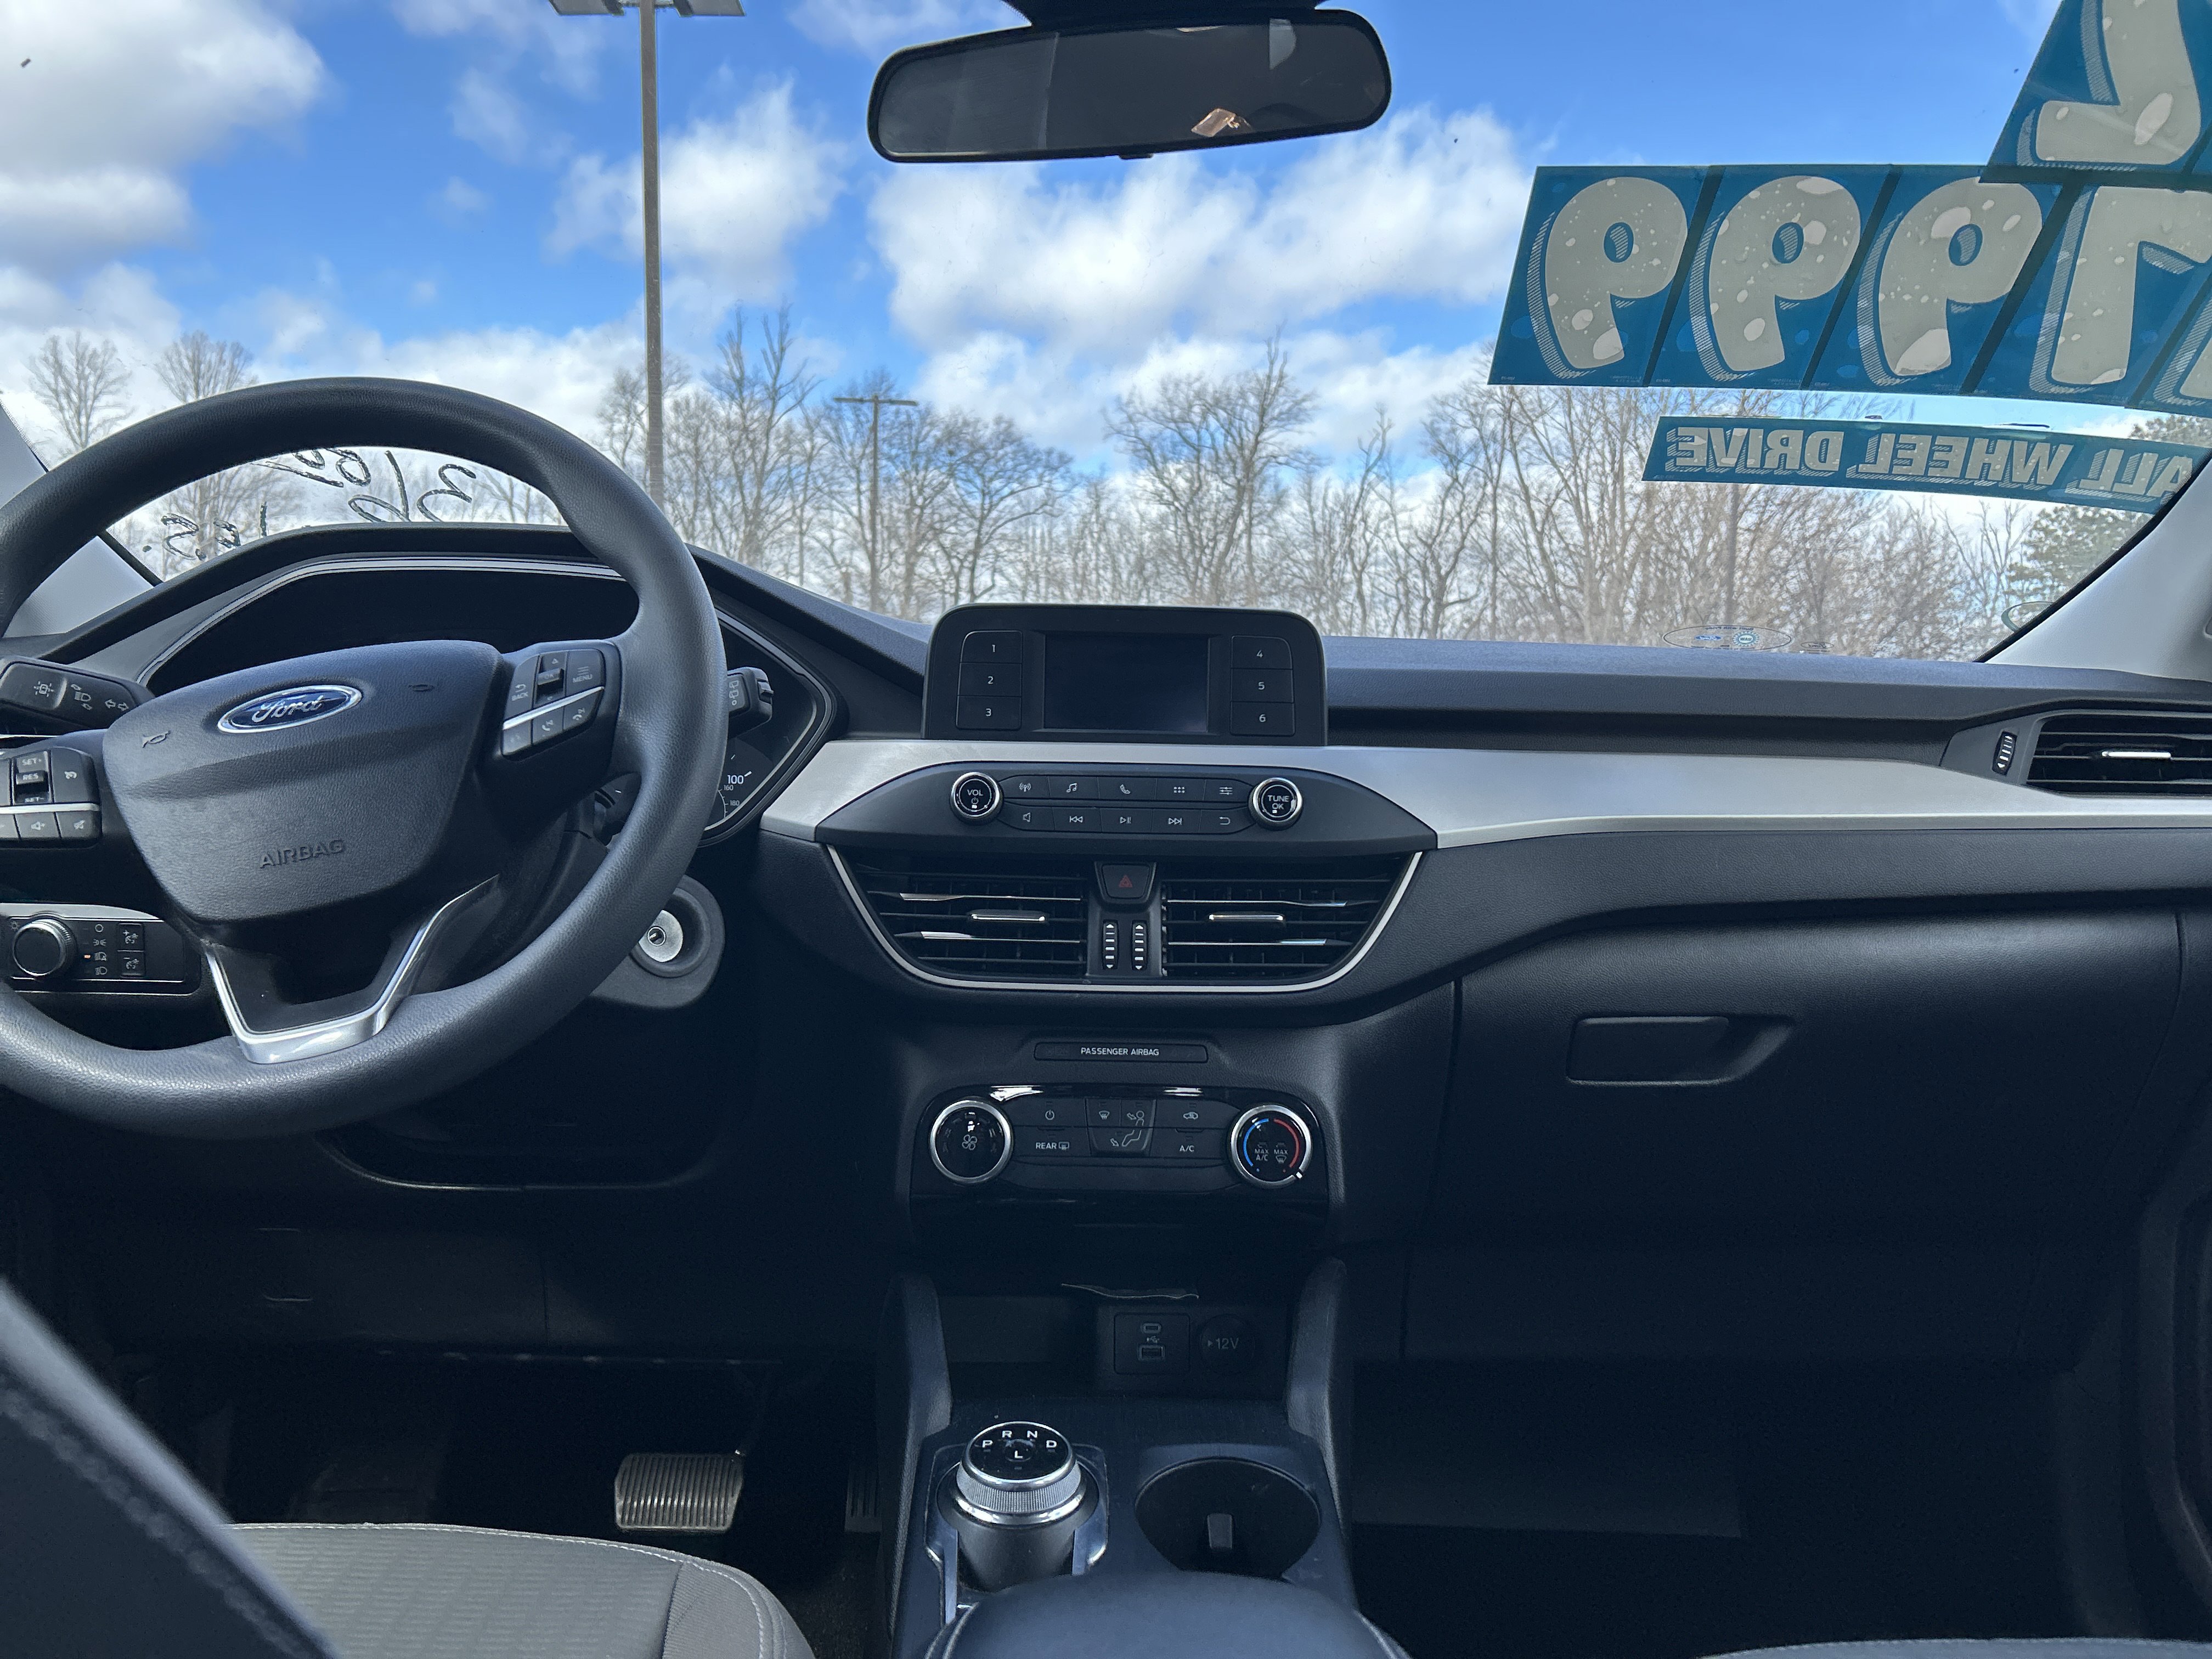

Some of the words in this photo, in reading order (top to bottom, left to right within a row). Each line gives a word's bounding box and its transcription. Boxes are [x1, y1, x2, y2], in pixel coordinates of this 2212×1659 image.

[1256, 650, 1263, 658] 4
[572, 674, 593, 683] MENU
[988, 676, 994, 684] 2
[1258, 681, 1265, 690] 5
[511, 691, 528, 701] BACK
[251, 694, 325, 723] Ford
[1259, 714, 1266, 723] 6
[22, 772, 39, 781] RES
[727, 775, 744, 785] 100
[967, 788, 984, 797] VOL
[1267, 794, 1290, 803] TUNE
[258, 839, 345, 868] AIRBAG
[1080, 1047, 1128, 1056] PASSENGER
[1131, 1047, 1159, 1056] AIRBAG
[1035, 1141, 1057, 1150] REAR
[1180, 1144, 1195, 1153] A/C
[1215, 1338, 1240, 1350] 12V
[982, 1440, 993, 1448] P
[1002, 1430, 1012, 1438] R
[1027, 1430, 1038, 1438] N
[1046, 1440, 1057, 1448] D
[1014, 1451, 1023, 1459] L
